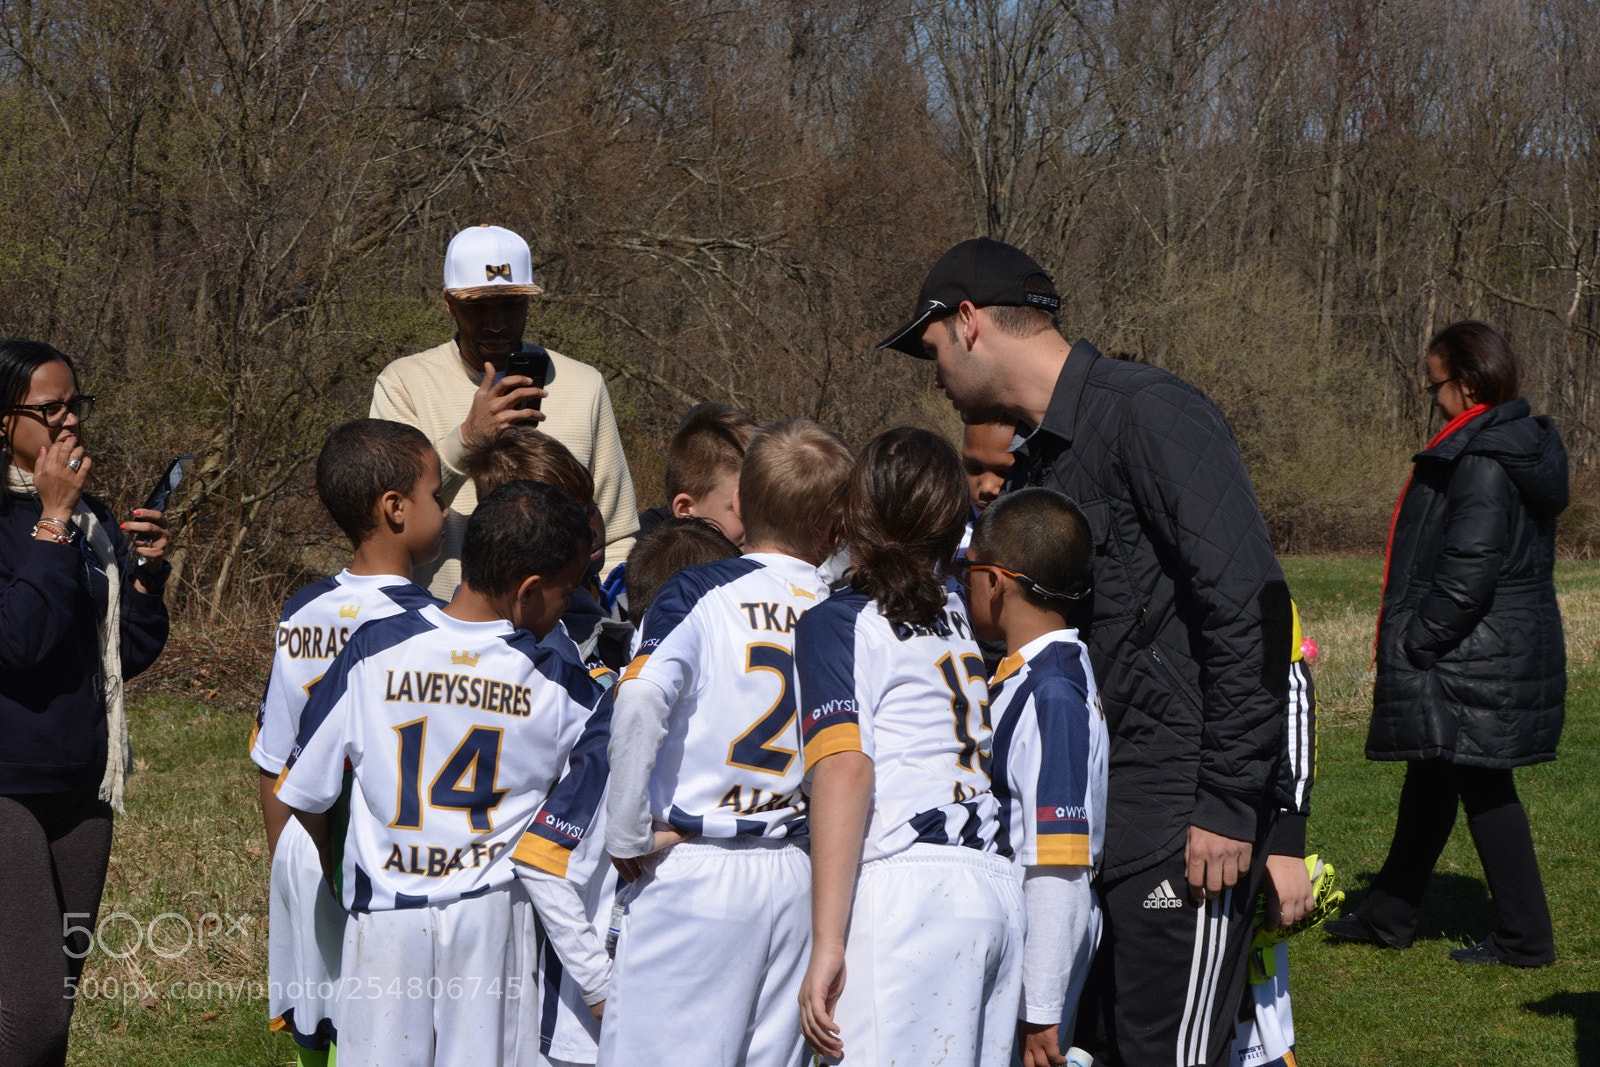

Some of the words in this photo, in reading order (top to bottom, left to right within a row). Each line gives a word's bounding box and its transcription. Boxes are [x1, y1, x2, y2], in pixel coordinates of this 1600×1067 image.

[739, 602, 807, 634] TKA
[278, 625, 349, 659] PORRAS
[385, 669, 531, 717] LAVEYSSIERES
[725, 641, 798, 777] 2
[821, 699, 859, 715] WYSL
[387, 716, 511, 834] 14
[555, 817, 584, 840] WYSL
[1065, 806, 1089, 819] WYS
[382, 843, 465, 878] ALBA
[1142, 896, 1183, 910] adidas
